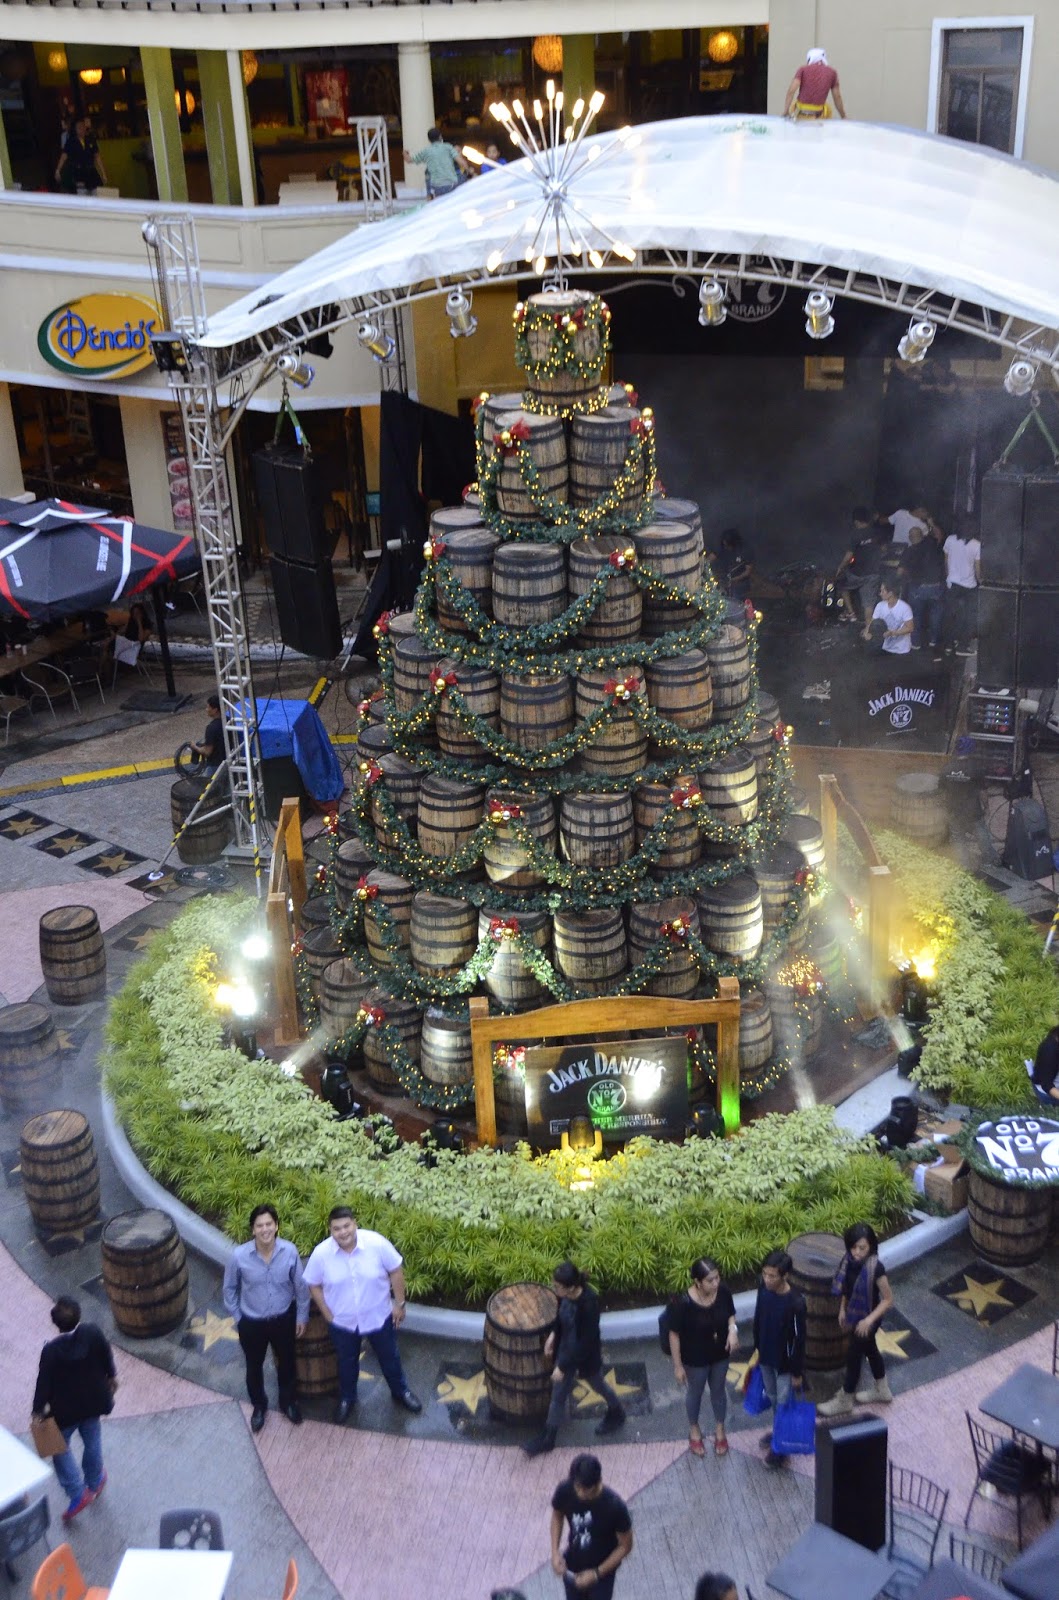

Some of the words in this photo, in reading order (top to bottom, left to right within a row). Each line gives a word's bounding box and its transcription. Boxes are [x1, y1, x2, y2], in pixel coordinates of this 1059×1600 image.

[56, 309, 155, 357] Dencio's
[868, 692, 895, 716] JACK
[894, 686, 935, 707] DANIEL'S
[546, 1058, 593, 1093] JACK
[598, 1082, 615, 1090] OLD
[995, 1121, 1040, 1135] OLD
